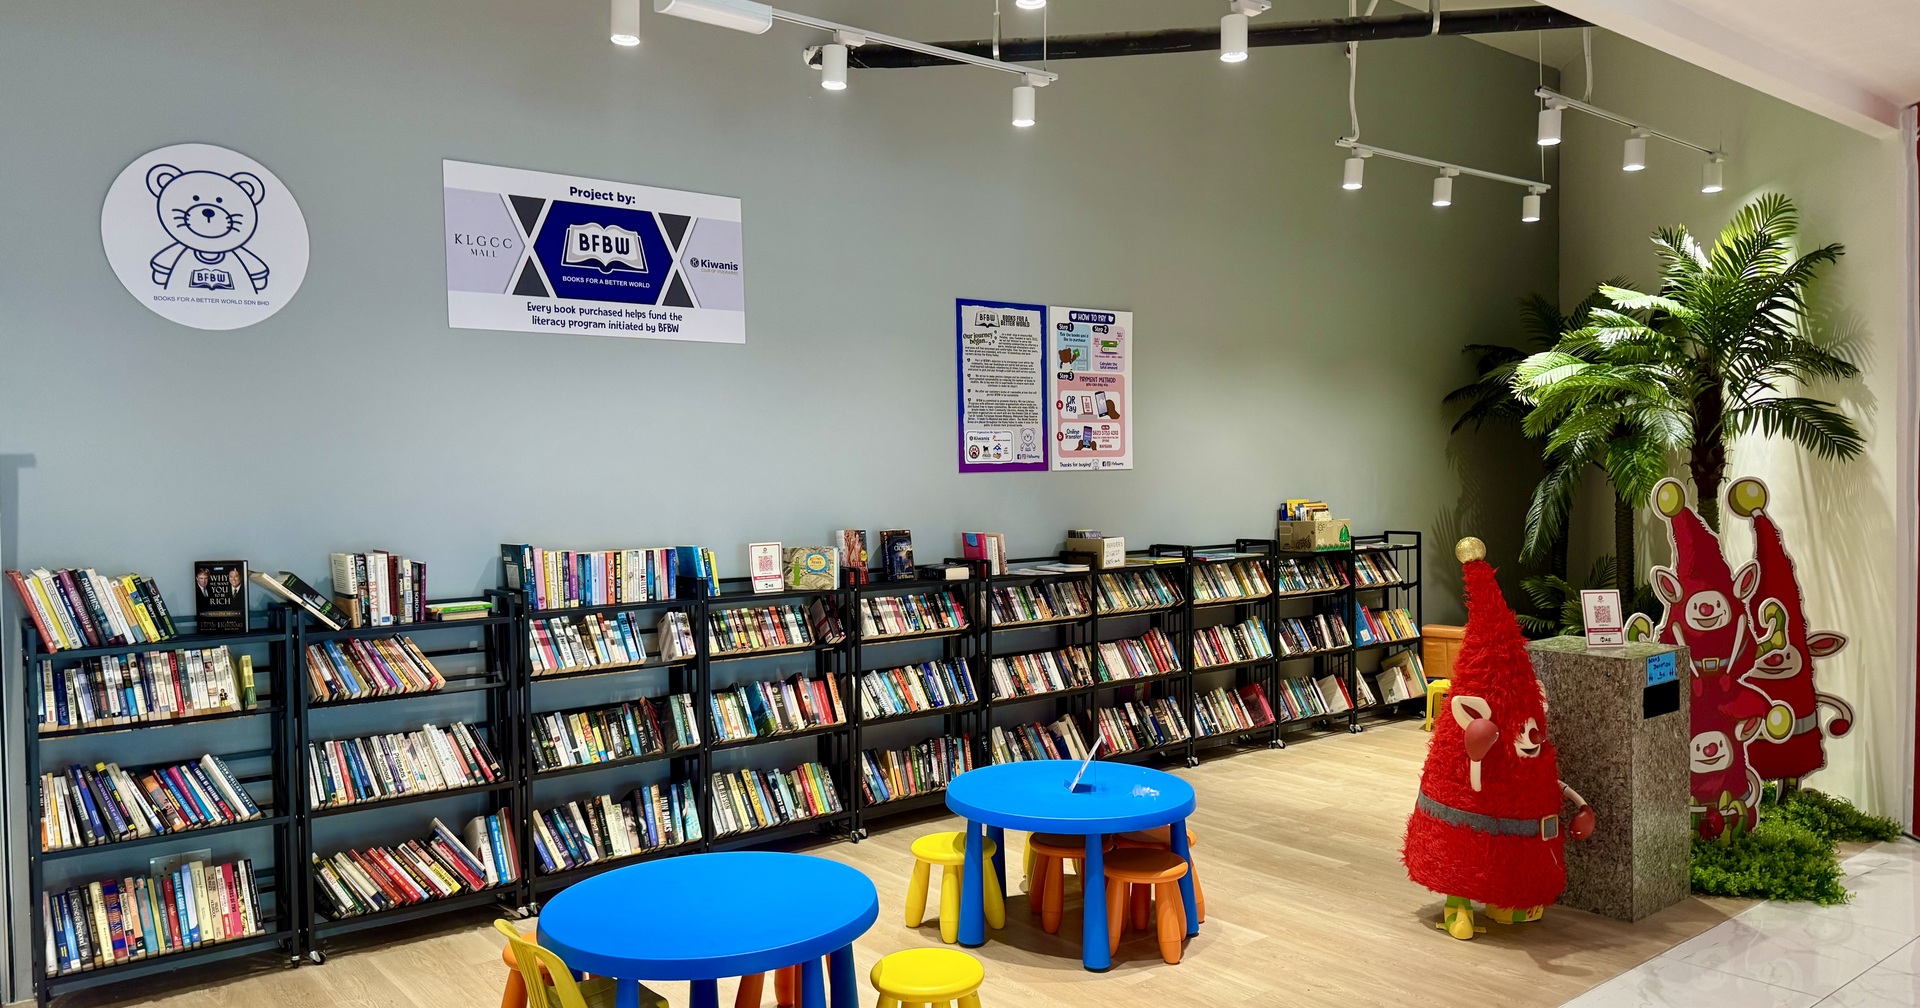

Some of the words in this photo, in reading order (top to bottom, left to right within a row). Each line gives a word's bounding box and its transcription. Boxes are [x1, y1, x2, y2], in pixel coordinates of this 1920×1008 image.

[569, 186, 613, 201] Project
[617, 192, 636, 205] by:
[454, 234, 512, 249] KLGCC
[579, 233, 630, 255] BFBW
[470, 249, 498, 258] MALL
[700, 259, 738, 271] Kiwanis
[197, 273, 226, 282] BFBW
[605, 279, 628, 287] BETTER
[527, 302, 552, 314] Every
[554, 304, 576, 314] book
[579, 306, 623, 318] purchased
[625, 308, 646, 320] helps
[648, 310, 667, 320] fund
[670, 312, 683, 322] the
[1078, 313, 1090, 321] HOW
[1098, 314, 1107, 322] PAY
[532, 315, 566, 328] literacy
[568, 319, 606, 330] program
[608, 320, 644, 331] initiated
[645, 321, 656, 333] by
[658, 323, 679, 333] BFBW
[1067, 396, 1075, 404] QR
[1066, 403, 1076, 413] Pay
[210, 574, 229, 582] WHY
[80, 577, 101, 610] CHAOTICS
[369, 582, 378, 612] BRAVE
[215, 757, 229, 775] BILLION
[228, 775, 242, 792] DOLLAR
[240, 792, 253, 808] WHALE
[715, 774, 724, 788] BILL
[659, 796, 670, 810] IAIN
[719, 787, 731, 810] BRYSON
[661, 810, 673, 833] BANKS
[498, 855, 506, 872] Research
